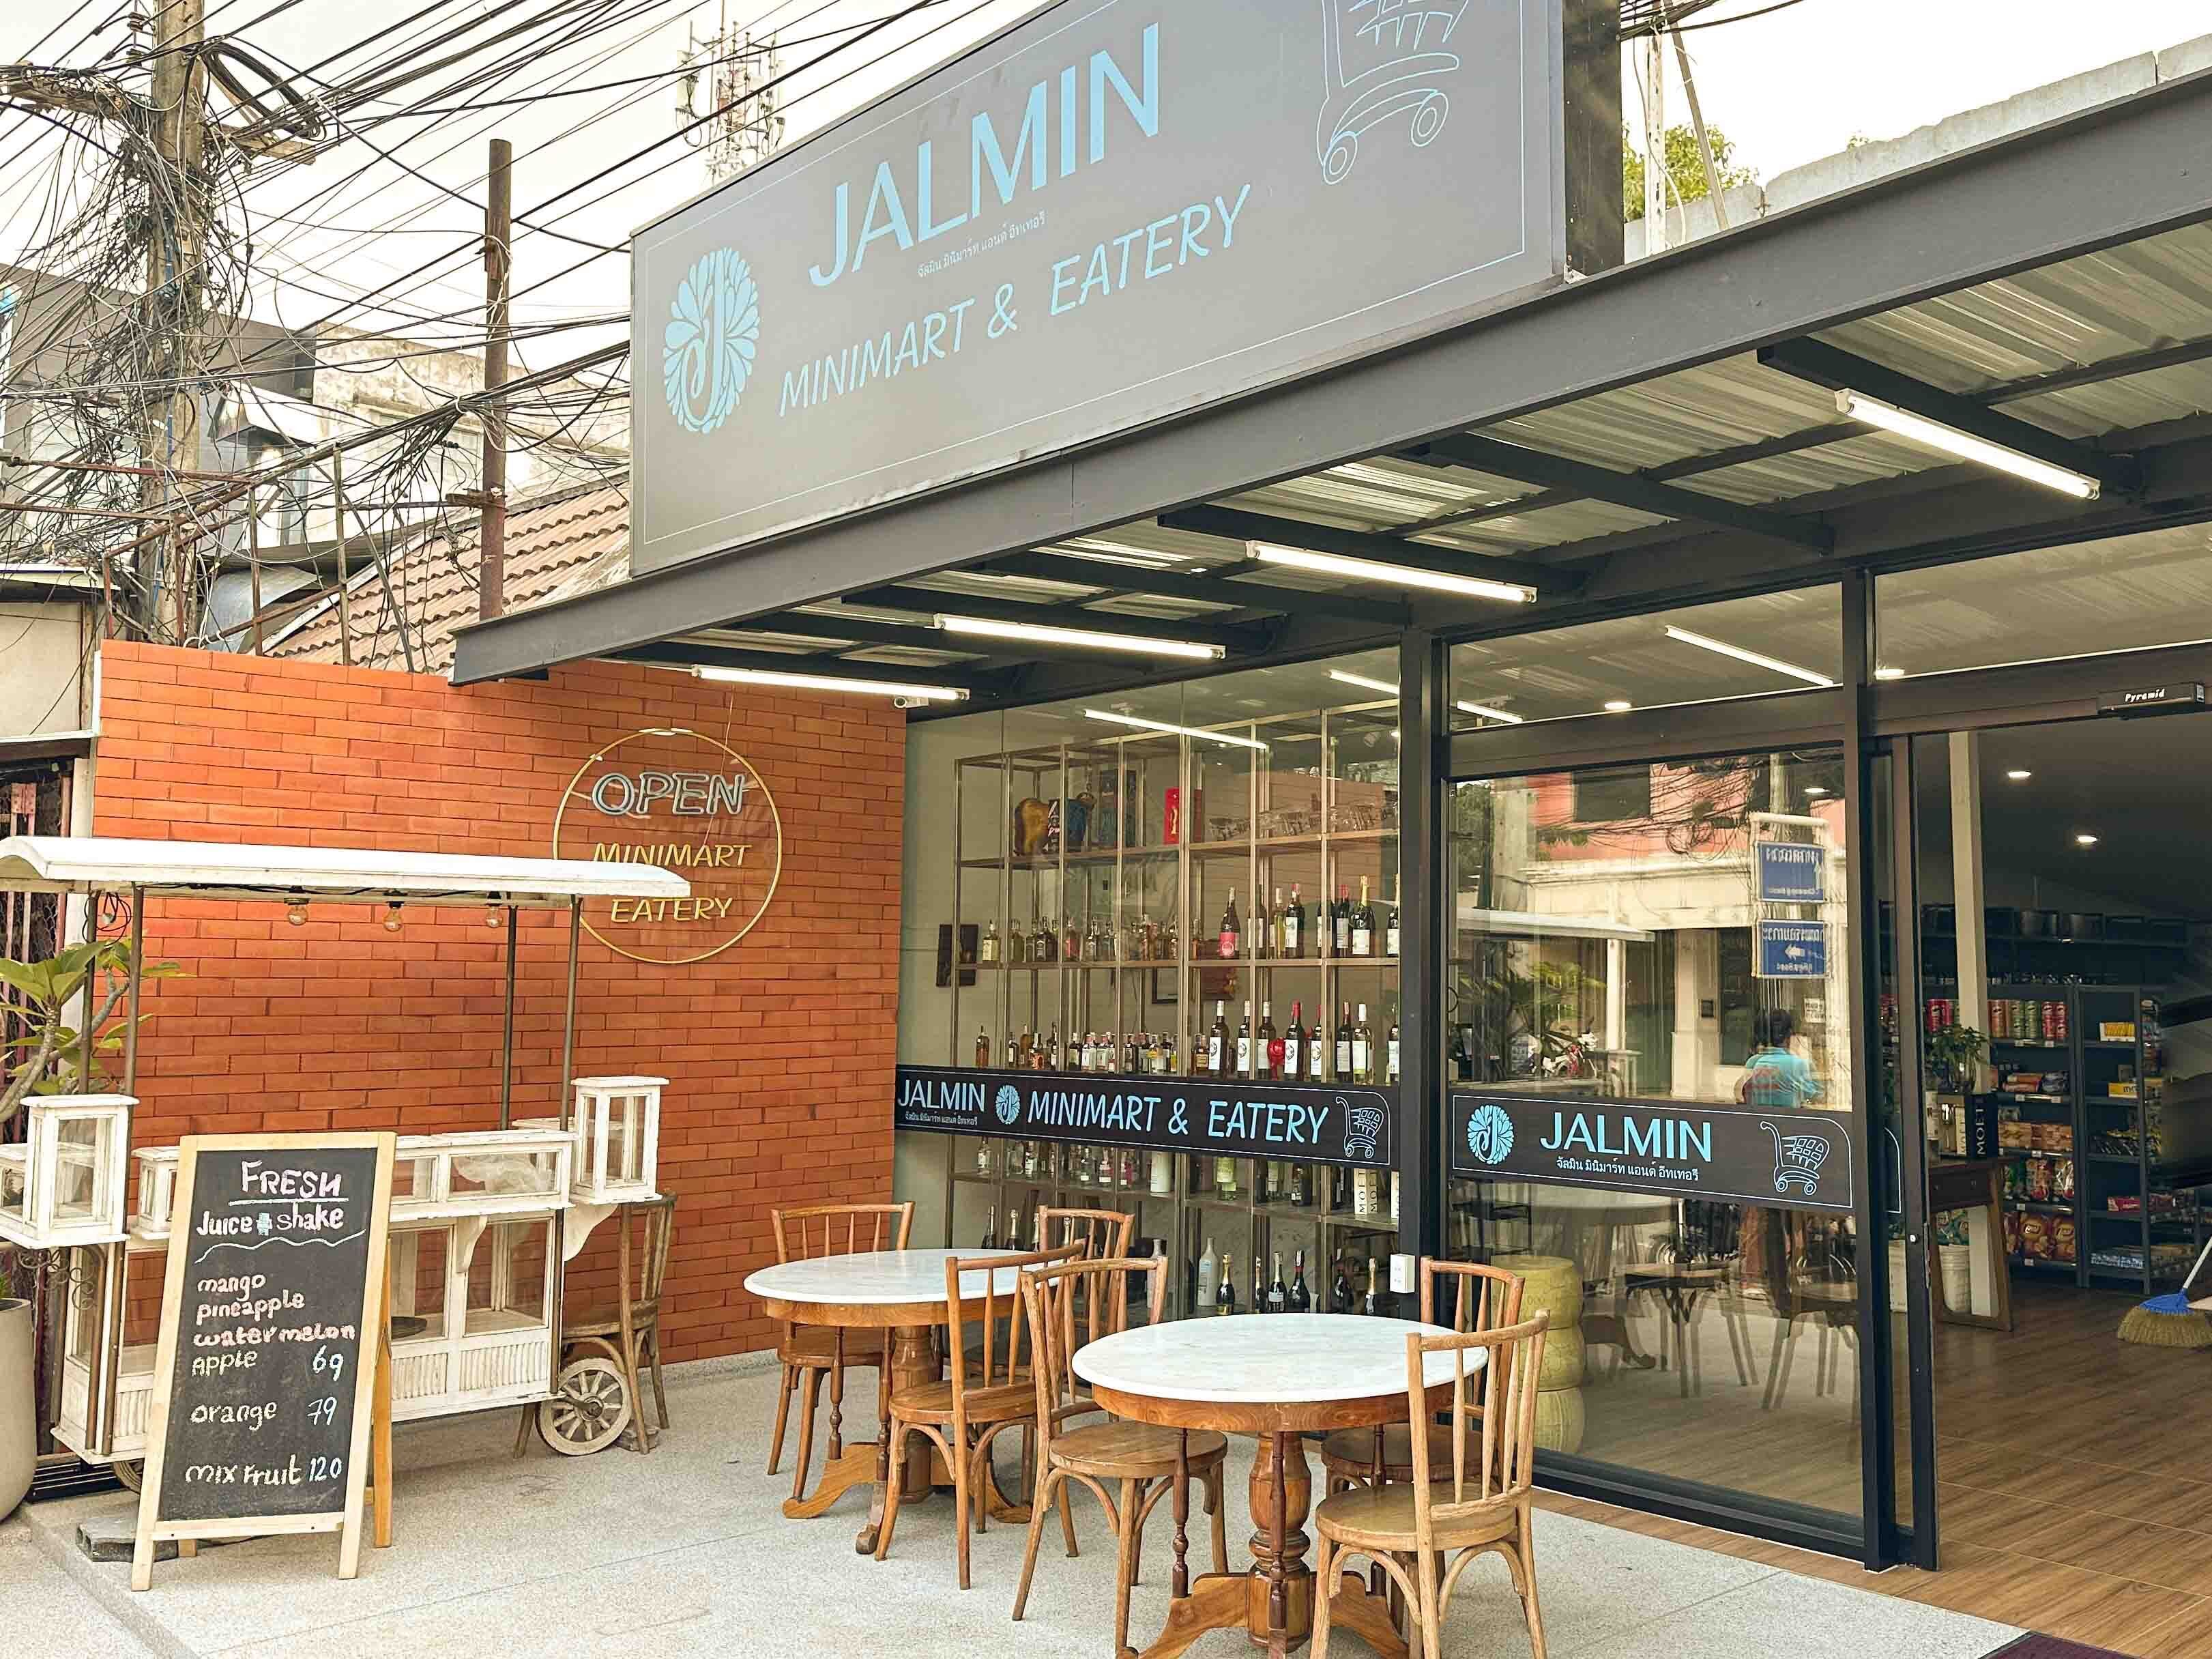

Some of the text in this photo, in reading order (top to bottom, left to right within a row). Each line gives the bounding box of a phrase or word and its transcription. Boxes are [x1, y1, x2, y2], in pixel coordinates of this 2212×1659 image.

[808, 22, 1159, 287] JALMIN
[779, 184, 1251, 418] MINIMART & EATERY
[2125, 689, 2165, 702] Pyramid
[592, 772, 745, 816] OPEN
[594, 843, 752, 867] MINIMART
[611, 897, 733, 922] EATERY
[897, 1080, 985, 1112] JALMIN
[1028, 1091, 1328, 1144] MINIMART & EATERY
[1540, 1112, 1713, 1163] JALMIN
[242, 1160, 342, 1198] FRESH
[1556, 1156, 1583, 1170] จัลมิน
[1585, 1157, 1625, 1175] มินิมาร์ท
[1628, 1161, 1656, 1178] แอนด์
[197, 1202, 344, 1235] Juice shake
[197, 1274, 266, 1302] mango
[196, 1289, 305, 1326] pineapple
[312, 1344, 343, 1381] 69
[190, 1396, 337, 1430] orange 79
[185, 1465, 237, 1484] mix
[309, 1456, 342, 1482] 120
